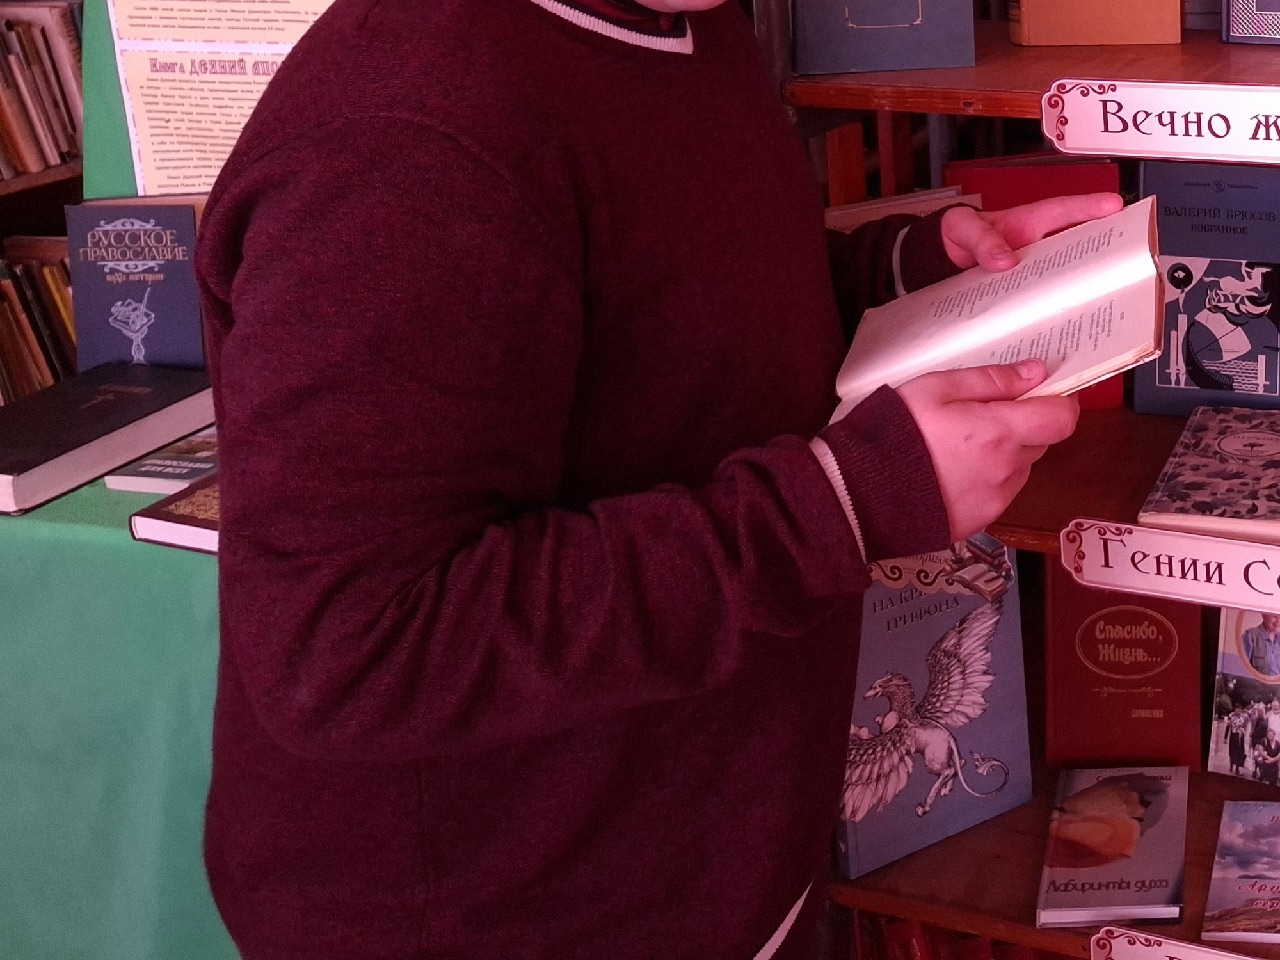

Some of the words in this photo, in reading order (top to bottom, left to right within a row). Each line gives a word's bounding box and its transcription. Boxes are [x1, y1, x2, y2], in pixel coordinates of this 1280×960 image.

[1100, 99, 1232, 139] Вечно
[1163, 206, 1221, 219] ВАЛЕРИЙ
[1226, 208, 1276, 222] БРЮСОВ
[87, 229, 178, 248] РУССКОЕ
[1190, 223, 1248, 236] ИЗБРАННОЕ
[79, 246, 188, 262] ПРАВОСЛАВИЕ
[1099, 537, 1224, 587] Гении
[873, 596, 895, 614] НА
[886, 596, 960, 632] ГРИФОНА
